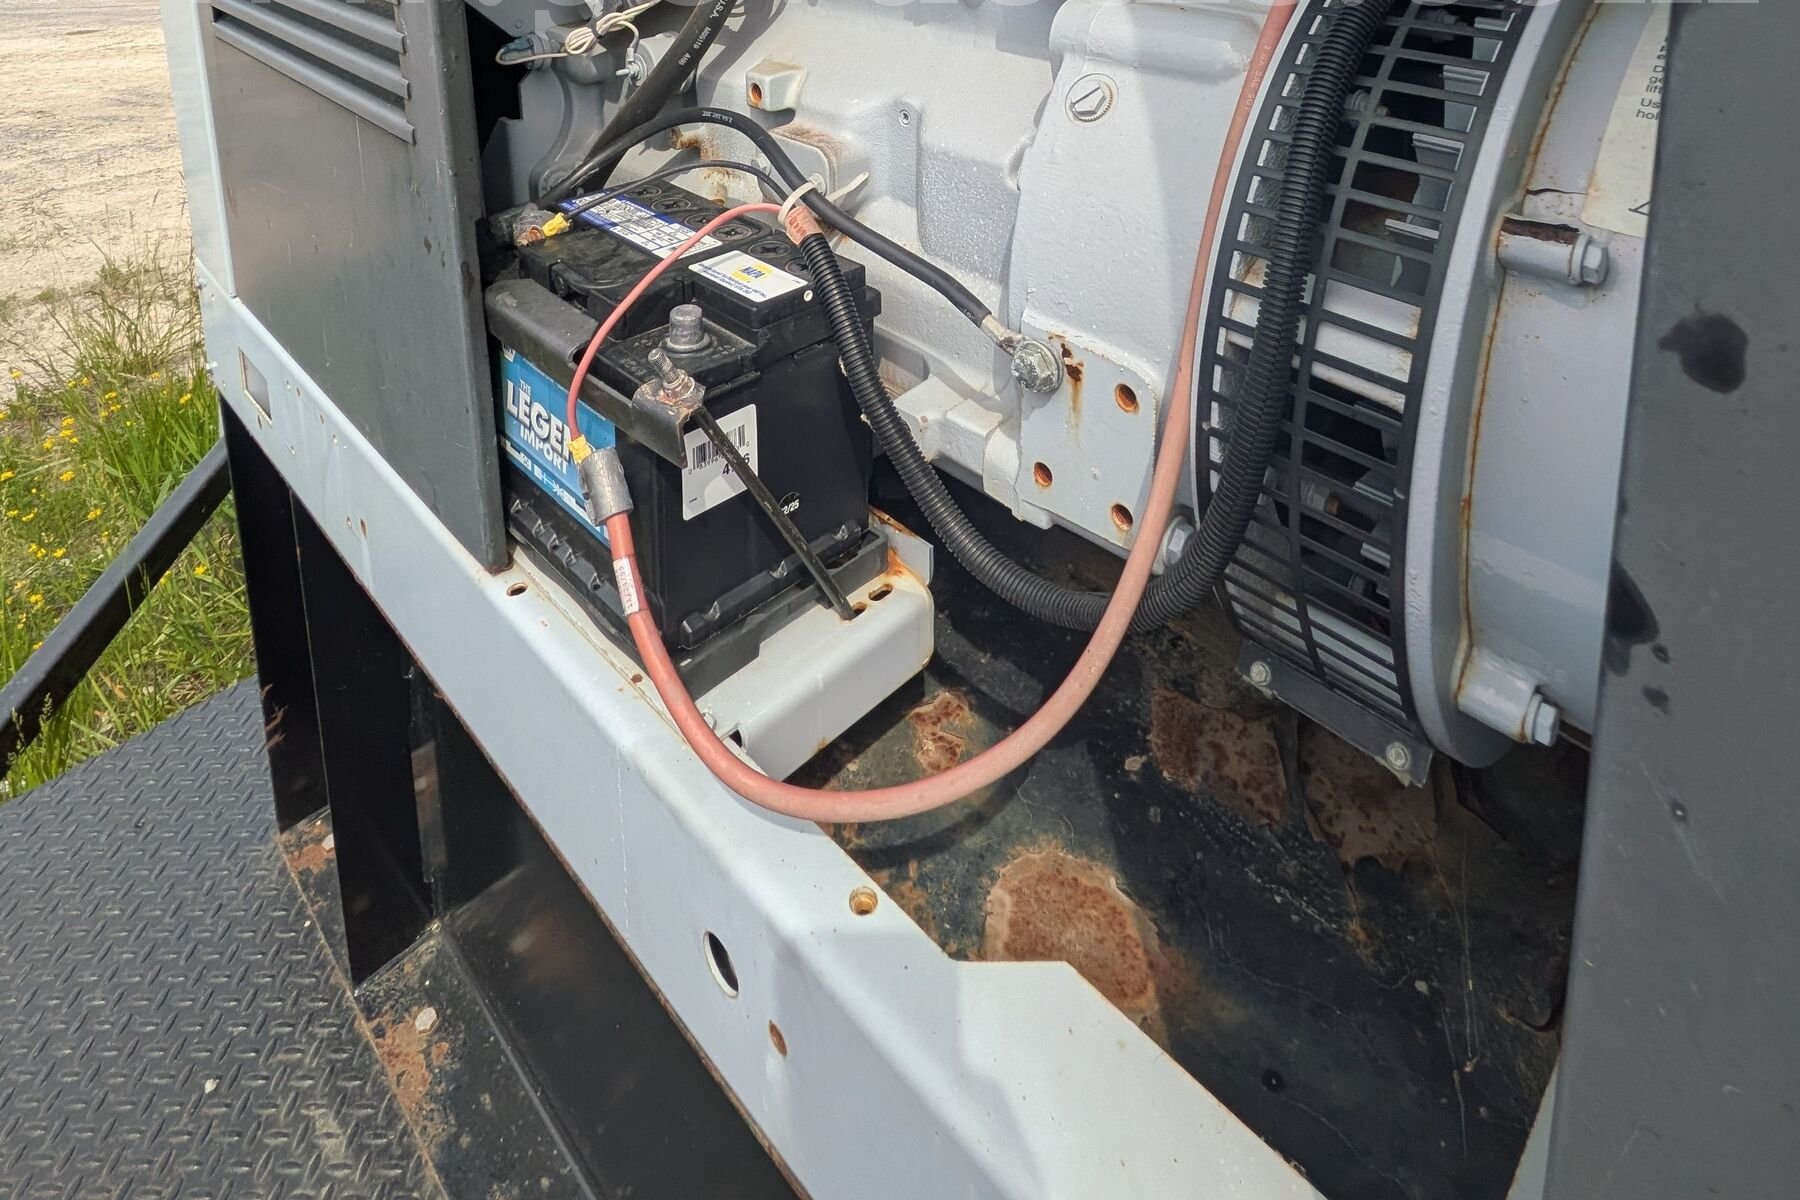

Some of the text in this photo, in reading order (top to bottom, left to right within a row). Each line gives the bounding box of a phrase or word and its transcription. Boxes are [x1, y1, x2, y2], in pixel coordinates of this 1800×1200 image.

[1641, 98, 1661, 109] Us
[520, 379, 531, 396] THE
[520, 425, 569, 476] IMPORT
[722, 453, 751, 475] 46
